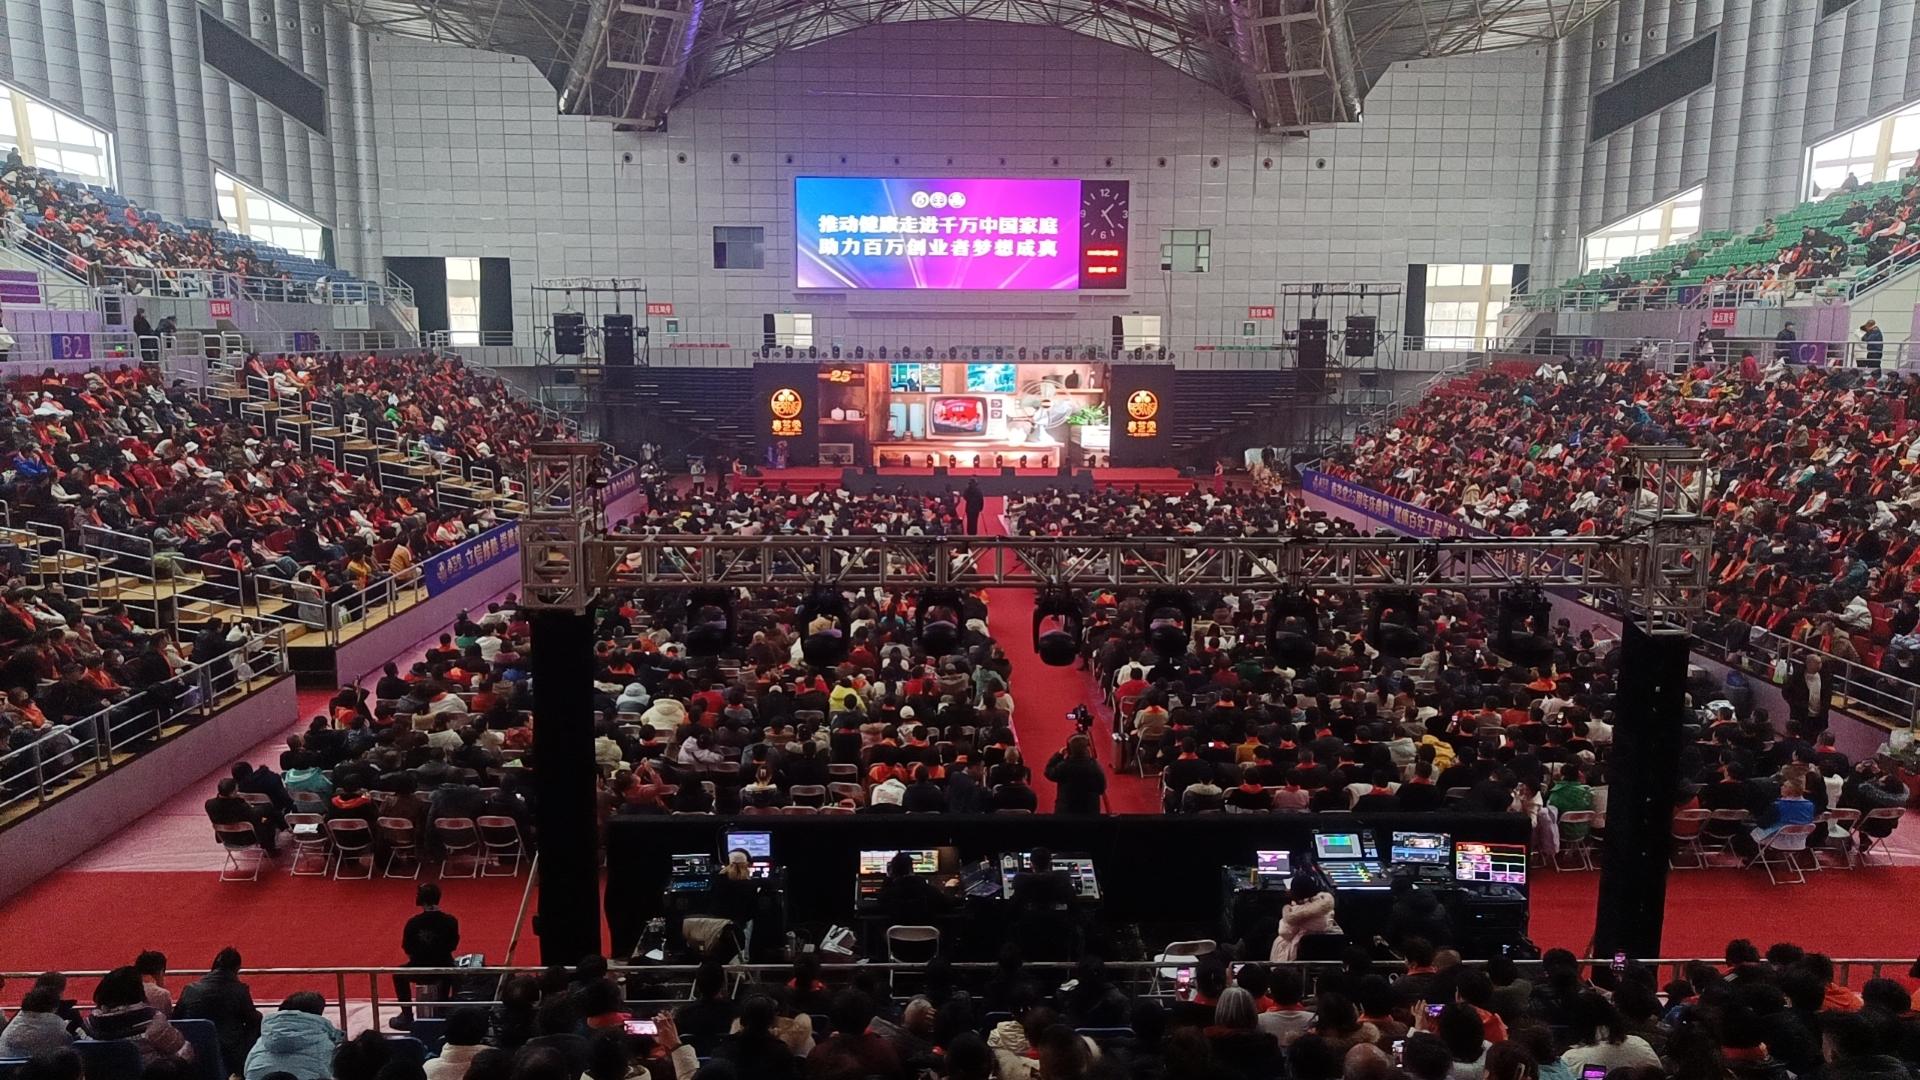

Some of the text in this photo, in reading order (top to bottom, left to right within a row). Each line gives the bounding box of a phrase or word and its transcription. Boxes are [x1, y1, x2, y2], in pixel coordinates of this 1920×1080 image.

[1100, 189, 1110, 197] 12
[1080, 210, 1128, 219] 9 3
[818, 214, 1059, 235] 推动健康走进千万中国家庭
[1100, 231, 1107, 239] 6
[818, 237, 1058, 257] 助力百万创业者梦想成真
[62, 335, 83, 358] B2
[1799, 344, 1818, 363] C2
[830, 369, 852, 383] 25
